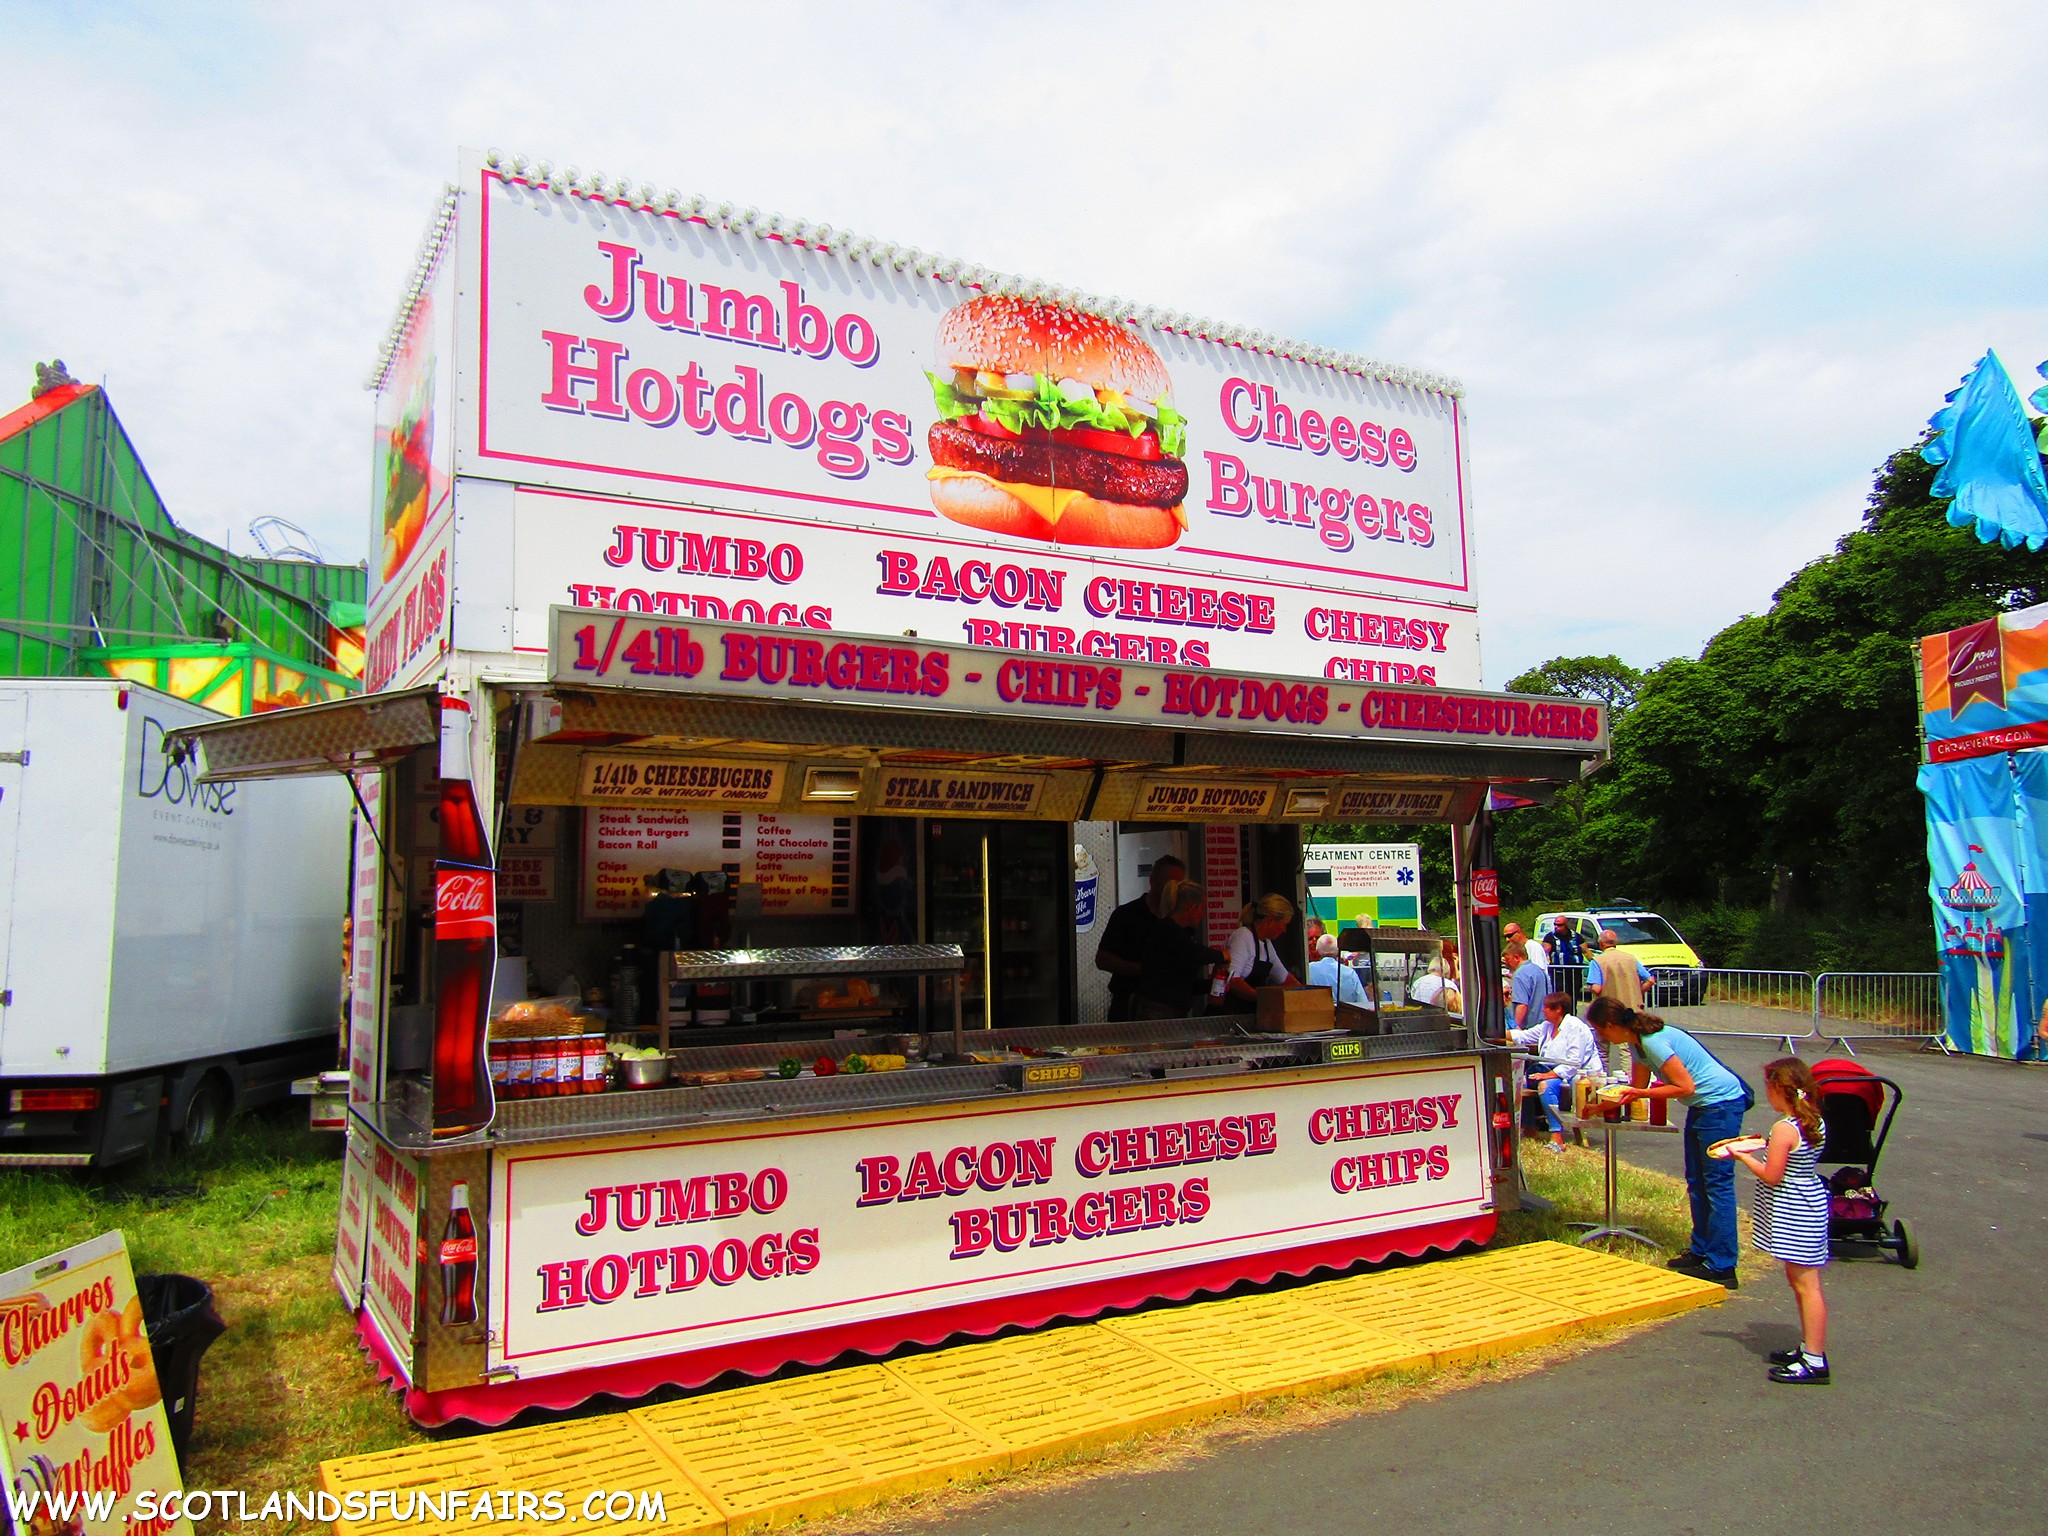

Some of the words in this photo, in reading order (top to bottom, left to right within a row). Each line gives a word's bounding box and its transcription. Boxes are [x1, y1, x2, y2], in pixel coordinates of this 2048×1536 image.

[584, 240, 880, 368] Jumbo
[541, 330, 914, 480] Hotdogs
[1220, 377, 1417, 472] Cheese
[1203, 451, 1434, 552] Burgers
[603, 524, 804, 585] JUMBO
[876, 550, 1067, 612] BACON
[1084, 576, 1276, 634] CHEESE
[401, 546, 447, 670] FLOSS
[1304, 606, 1450, 653] CHEESY
[963, 618, 1211, 668] BURGERS
[573, 617, 704, 678] 1/4lb
[720, 632, 950, 697] BURGERS
[997, 658, 1123, 710] CHIPS
[1162, 673, 1329, 725] HOTDOGS
[1361, 690, 1599, 741] CHEESEBURGERS
[1324, 656, 1437, 687] CHIPS
[593, 763, 638, 786] 1/4lb
[644, 765, 773, 789] CHEESEBUGERS
[592, 786, 626, 795] WITH
[632, 787, 653, 795] OR
[658, 788, 716, 797] WITHOUT
[721, 790, 768, 799] ONIONS
[886, 777, 942, 798] STEAK
[946, 780, 1035, 801] SANDWICH
[1148, 786, 1198, 804] JUMBO
[1201, 788, 1267, 806] HOTDOGS
[1341, 792, 1396, 808] CHICKEN
[1396, 793, 1443, 809] BURGER
[599, 815, 631, 824] Steak
[637, 815, 689, 824] Sandwich
[757, 826, 791, 835] Coffee
[758, 814, 776, 822] Tea
[598, 827, 642, 836] Chicken
[647, 828, 689, 838] Burgers
[598, 840, 632, 849] Bacon
[637, 840, 657, 849] Roll
[757, 839, 774, 847] Hot
[779, 839, 828, 848] Chocolate
[597, 862, 627, 872] Chips
[756, 852, 813, 861] Cappuccino
[756, 863, 782, 871] Latte
[1369, 850, 1411, 860] CENTRE
[597, 874, 638, 884] Cheesy
[756, 875, 774, 883] Hot
[778, 875, 808, 883] Vimto
[596, 887, 626, 897] Chips
[632, 888, 640, 896] &
[762, 887, 791, 895] ottles
[810, 887, 829, 897] Pop
[762, 899, 788, 908] ater
[1331, 1044, 1360, 1058] CHIPS
[1028, 1067, 1079, 1081] CHIPS
[1308, 1093, 1462, 1145] CHEESY
[856, 1136, 1057, 1208] BACON
[1075, 1112, 1277, 1178] CHEESE
[1331, 1145, 1449, 1194] CHIPS
[575, 1167, 789, 1236] JUMBO
[949, 1177, 1211, 1260] BURGERS
[536, 1227, 821, 1313] HOTDOGS
[3, 1275, 114, 1368] Churros
[32, 1338, 131, 1442] Donuts
[53, 1416, 156, 1517] Waffles
